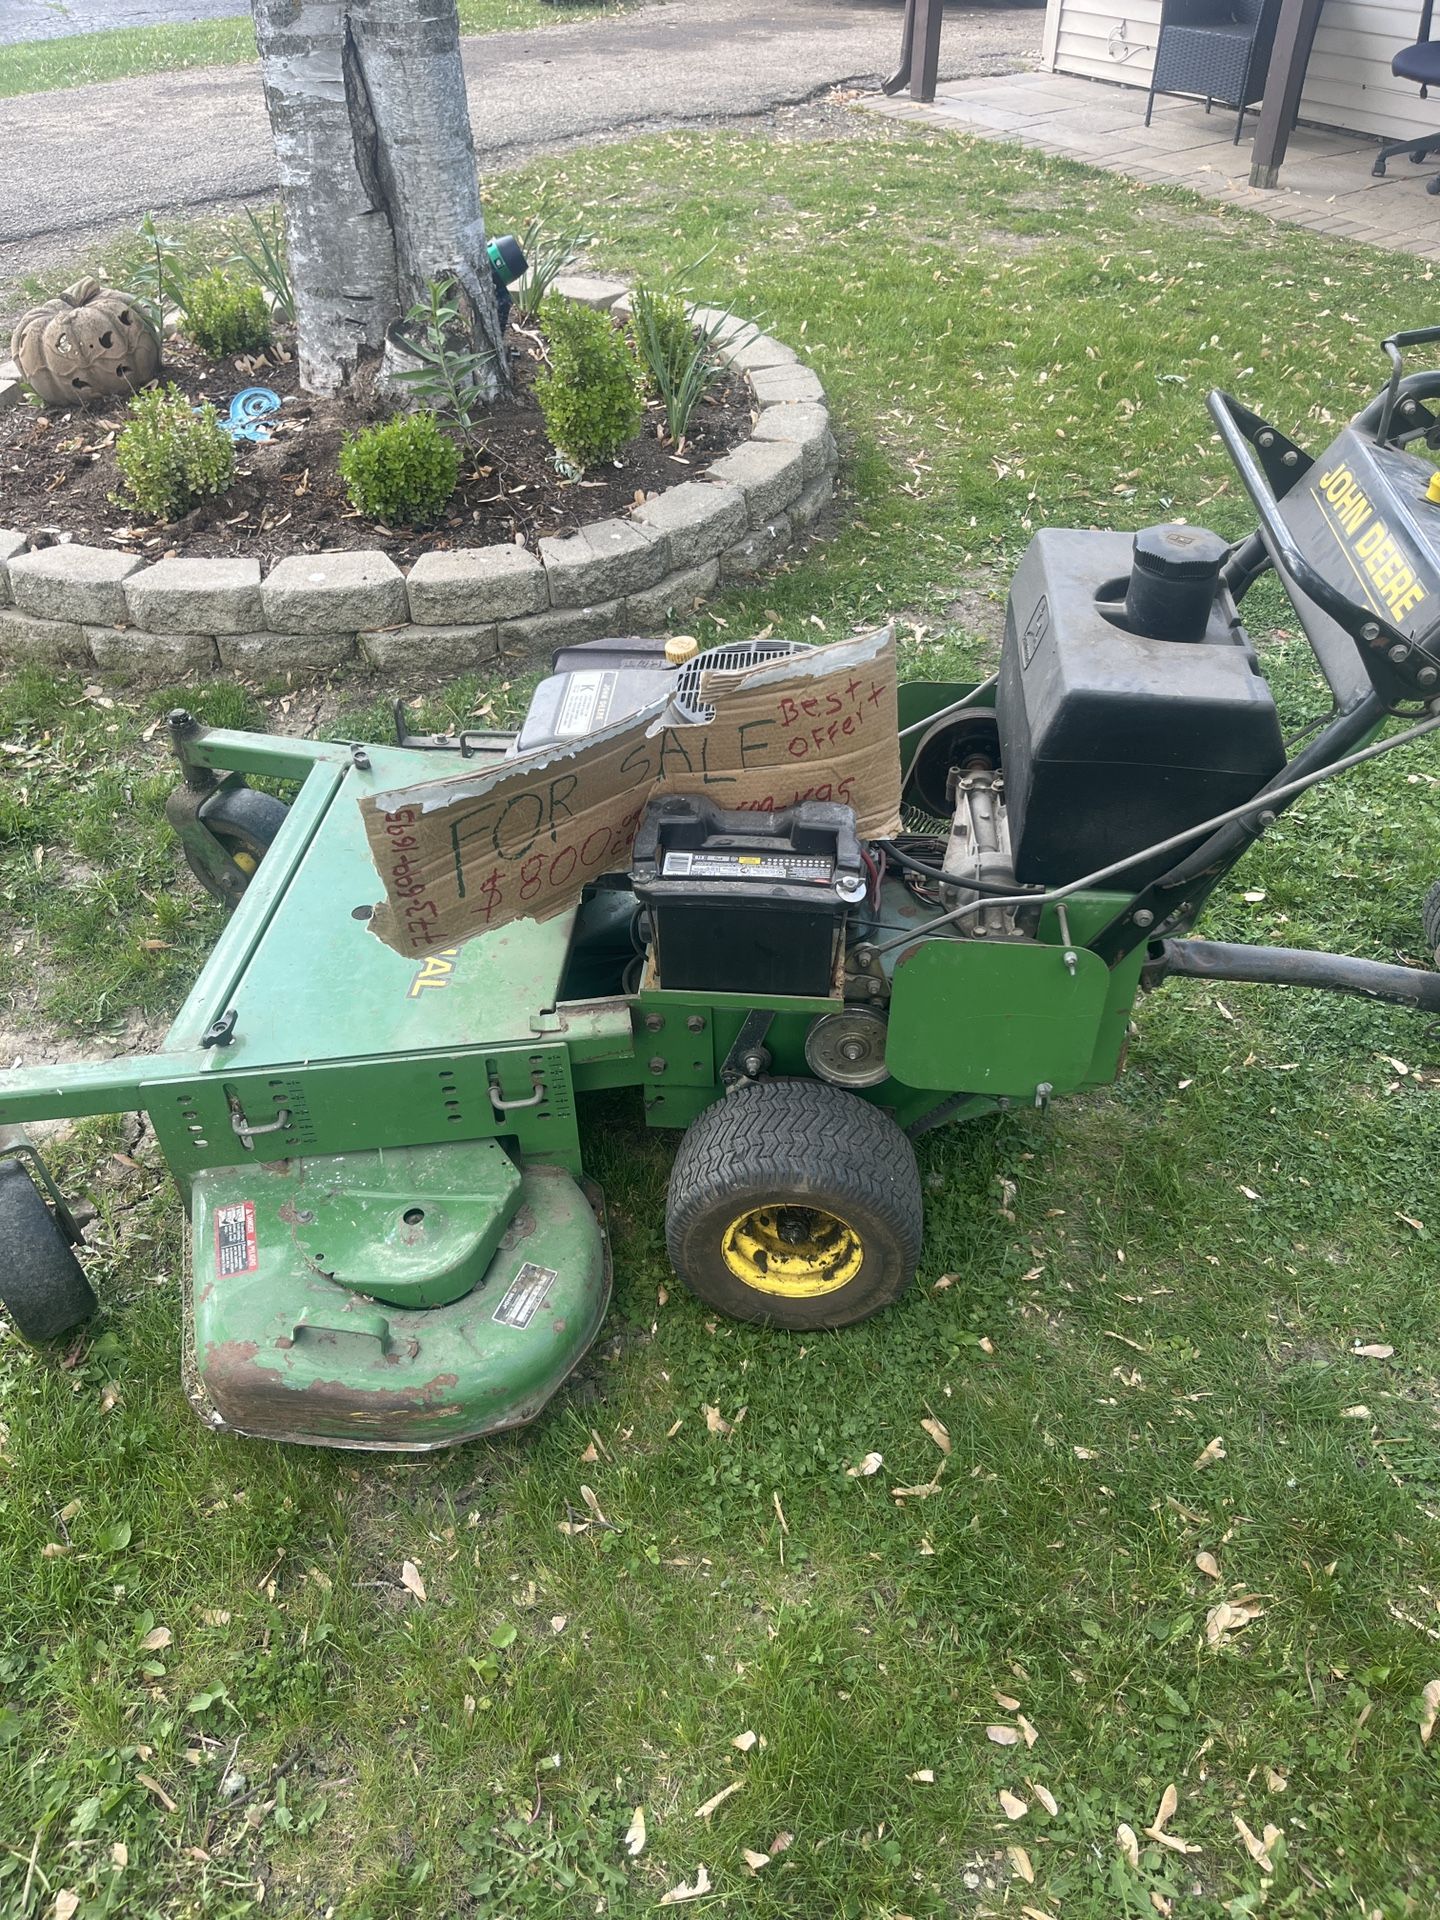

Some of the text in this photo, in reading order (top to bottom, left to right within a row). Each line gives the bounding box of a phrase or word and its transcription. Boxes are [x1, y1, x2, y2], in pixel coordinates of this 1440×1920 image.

[1319, 463, 1425, 623] JOHN DEERE
[450, 719, 777, 898] FOR SALE
